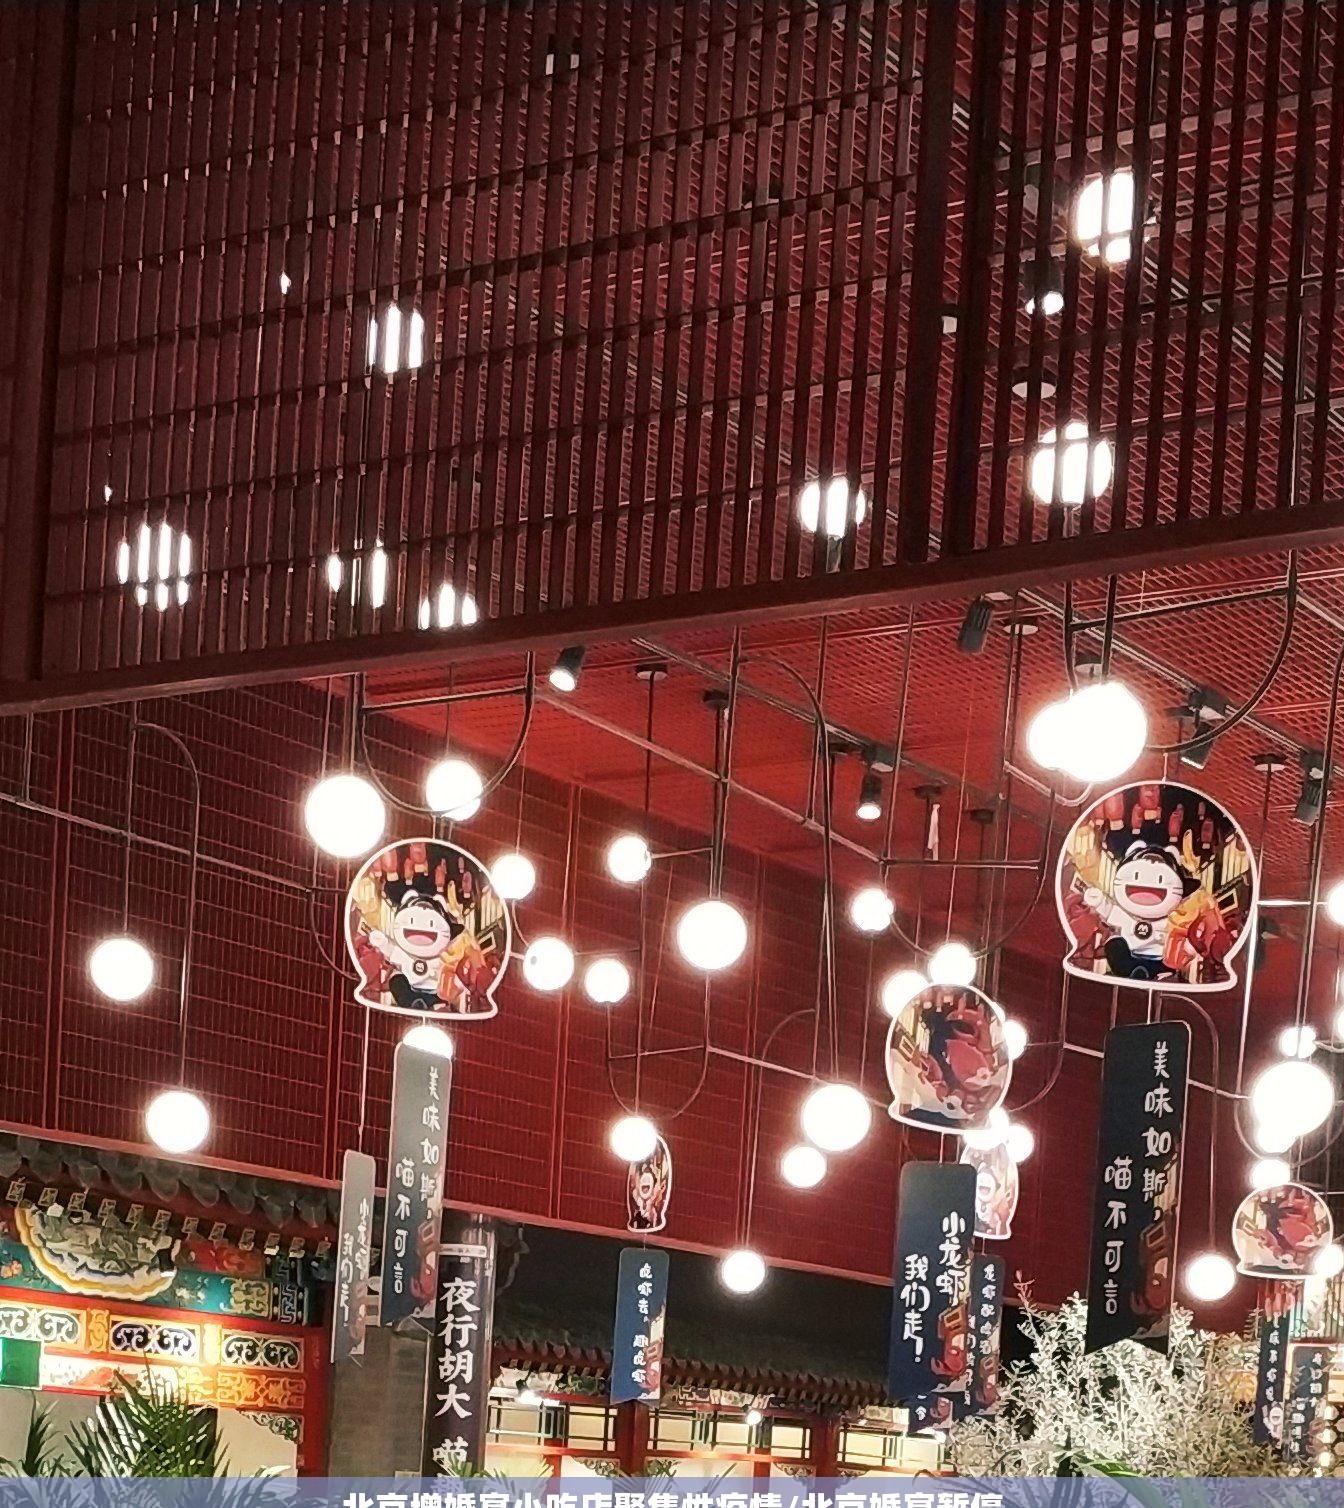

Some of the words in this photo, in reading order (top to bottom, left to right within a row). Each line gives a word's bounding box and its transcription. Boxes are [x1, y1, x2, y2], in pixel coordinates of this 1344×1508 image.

[935, 1211, 967, 1306] 小龙虾
[1104, 1156, 1133, 1315] 喵不可言
[435, 1277, 481, 1419] 夜行胡大
